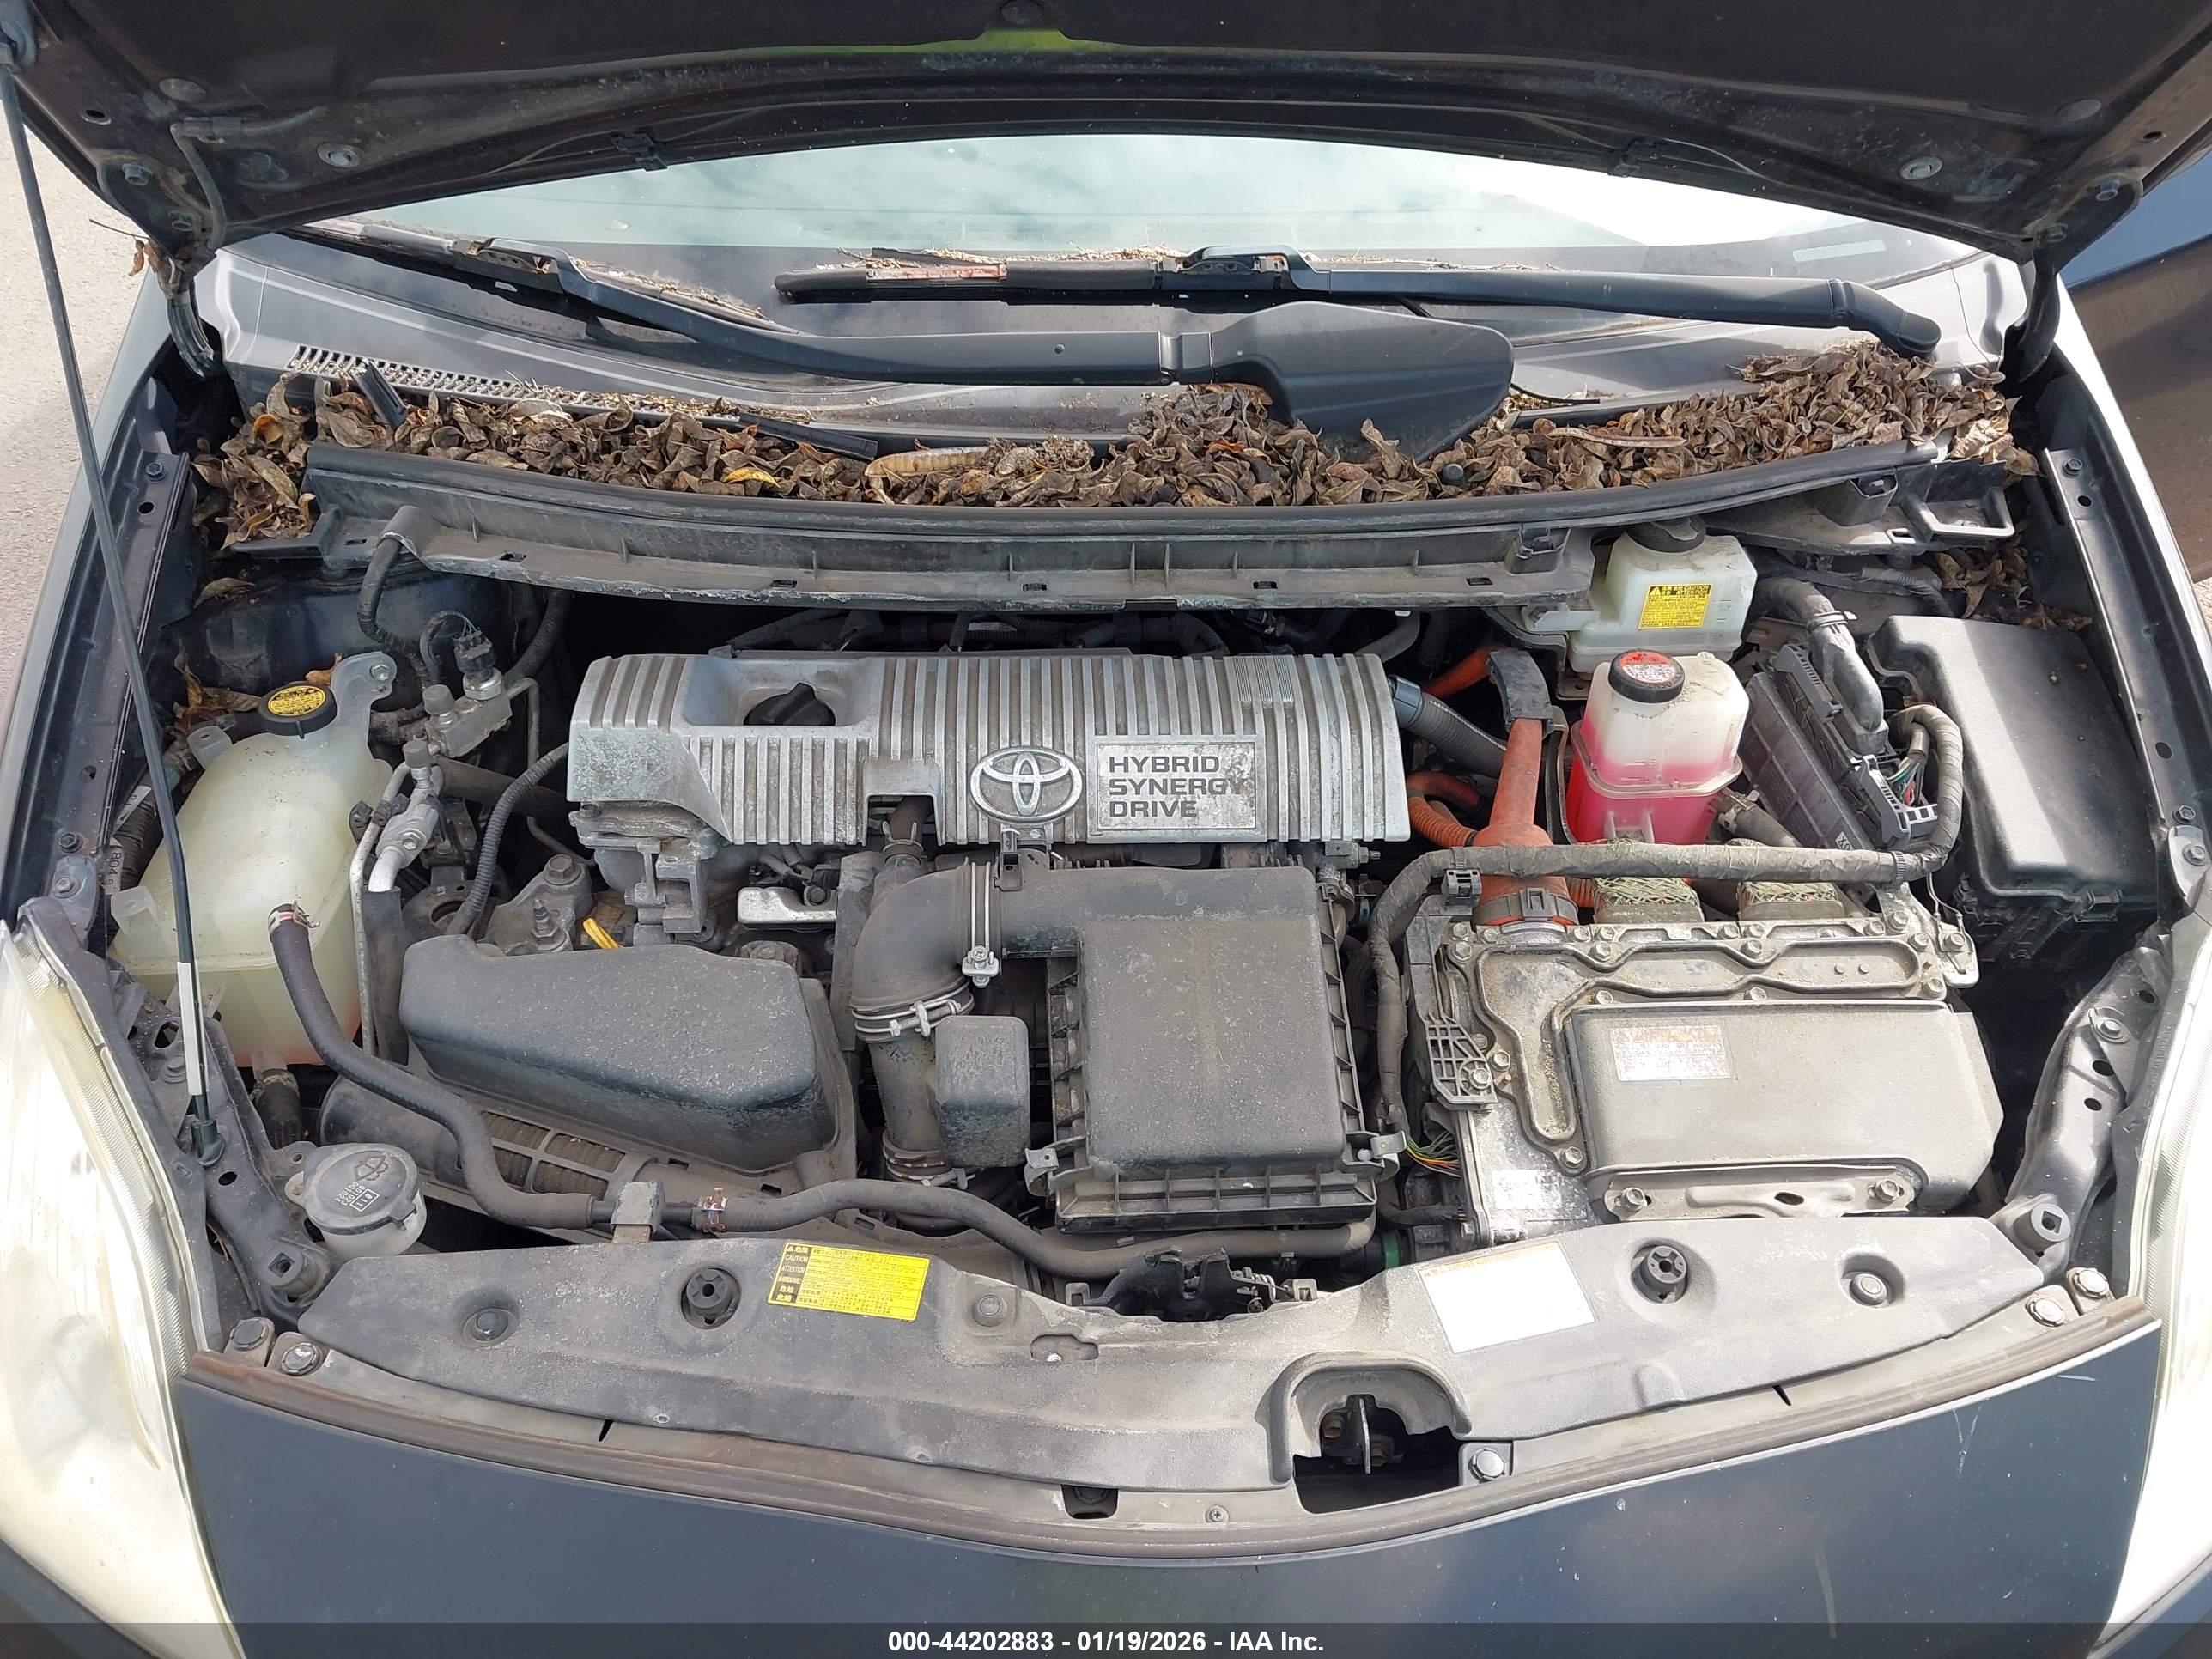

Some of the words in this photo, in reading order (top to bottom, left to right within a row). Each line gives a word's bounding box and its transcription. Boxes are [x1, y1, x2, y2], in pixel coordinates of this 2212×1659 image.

[1109, 756, 1219, 773] HYBRID
[1109, 778, 1245, 795] SYNERGY
[1109, 800, 1197, 817] DRIVE
[785, 1254, 809, 1263] CAUTION
[781, 1265, 805, 1273] ATTENTION
